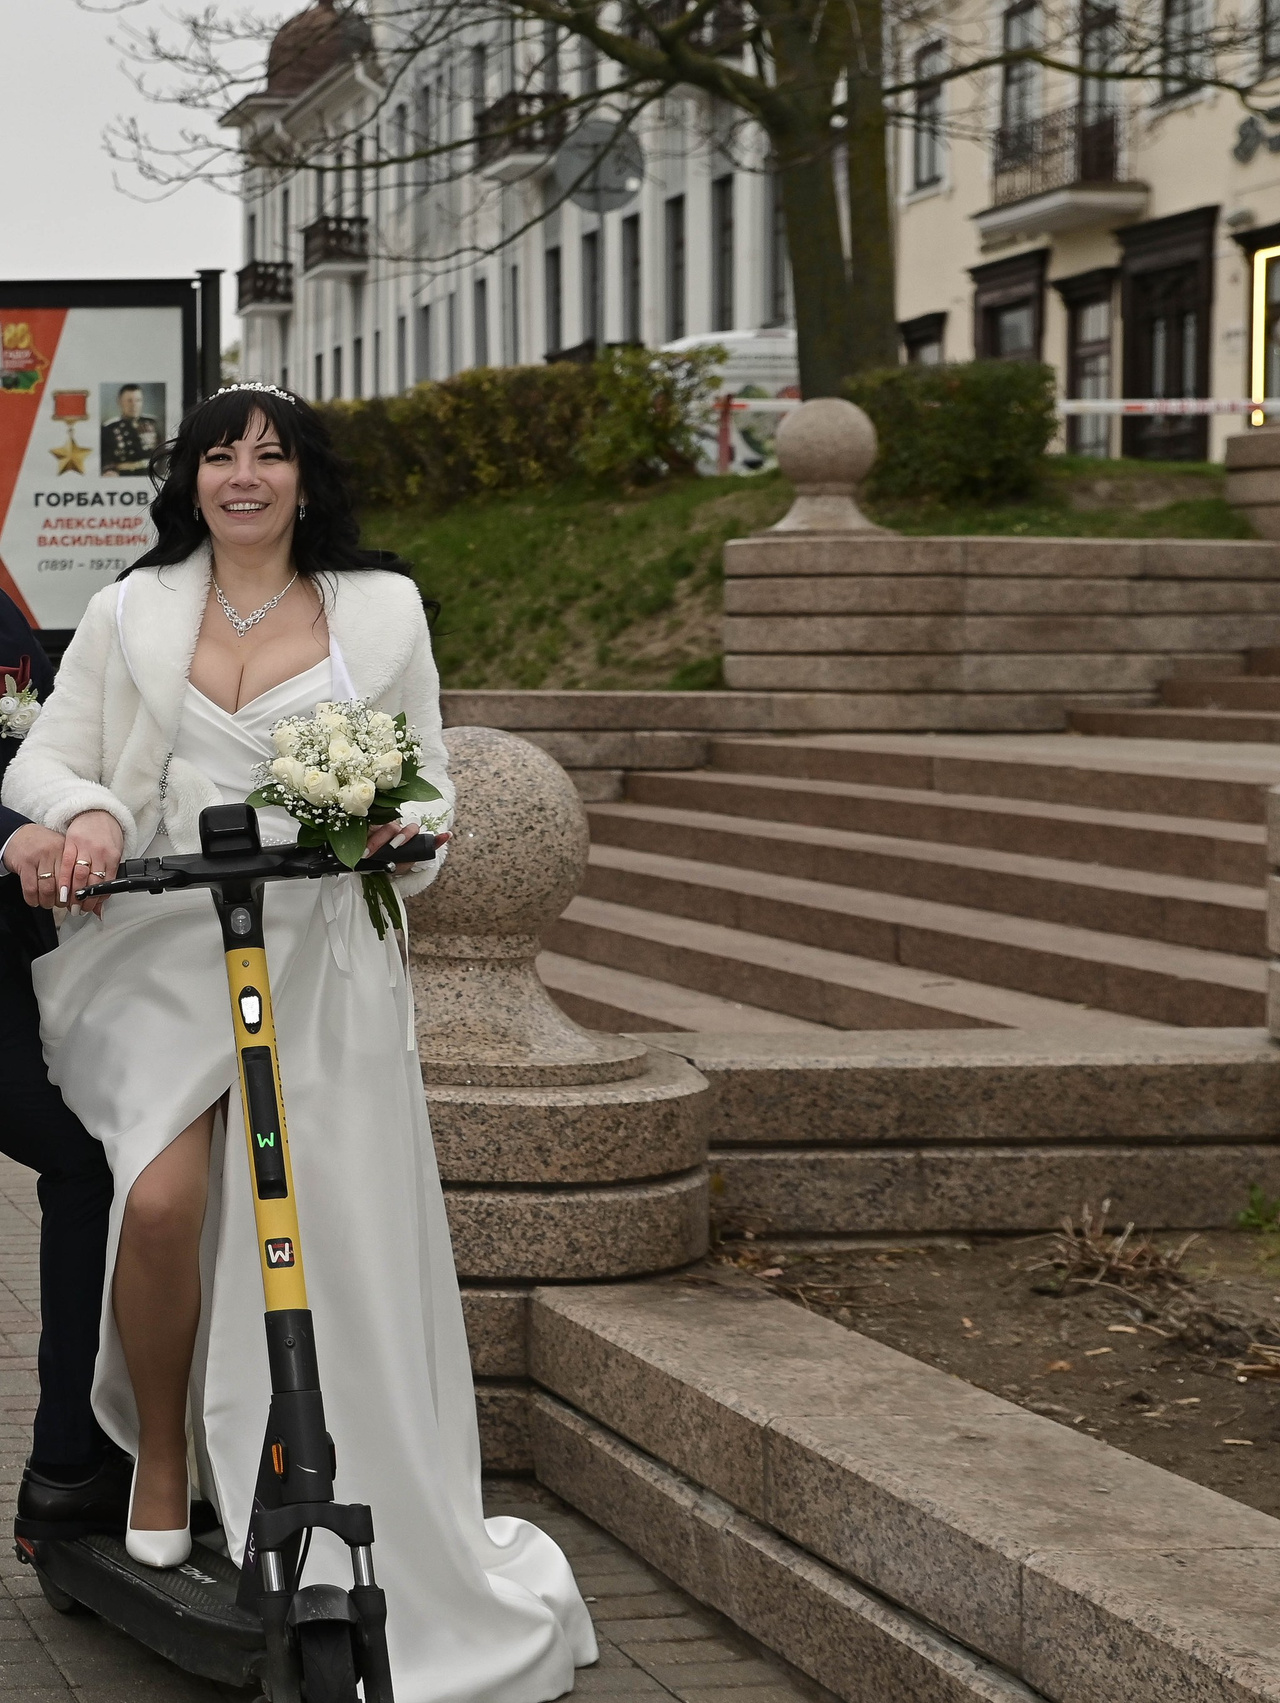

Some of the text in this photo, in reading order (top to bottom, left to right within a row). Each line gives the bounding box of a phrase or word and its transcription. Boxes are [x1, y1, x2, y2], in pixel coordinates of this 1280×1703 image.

[34, 491, 150, 507] ГОРБАТОВ
[42, 516, 144, 530] АЛЕКСАНДР
[37, 534, 148, 548] ВАСИЛЬЕВИЧ
